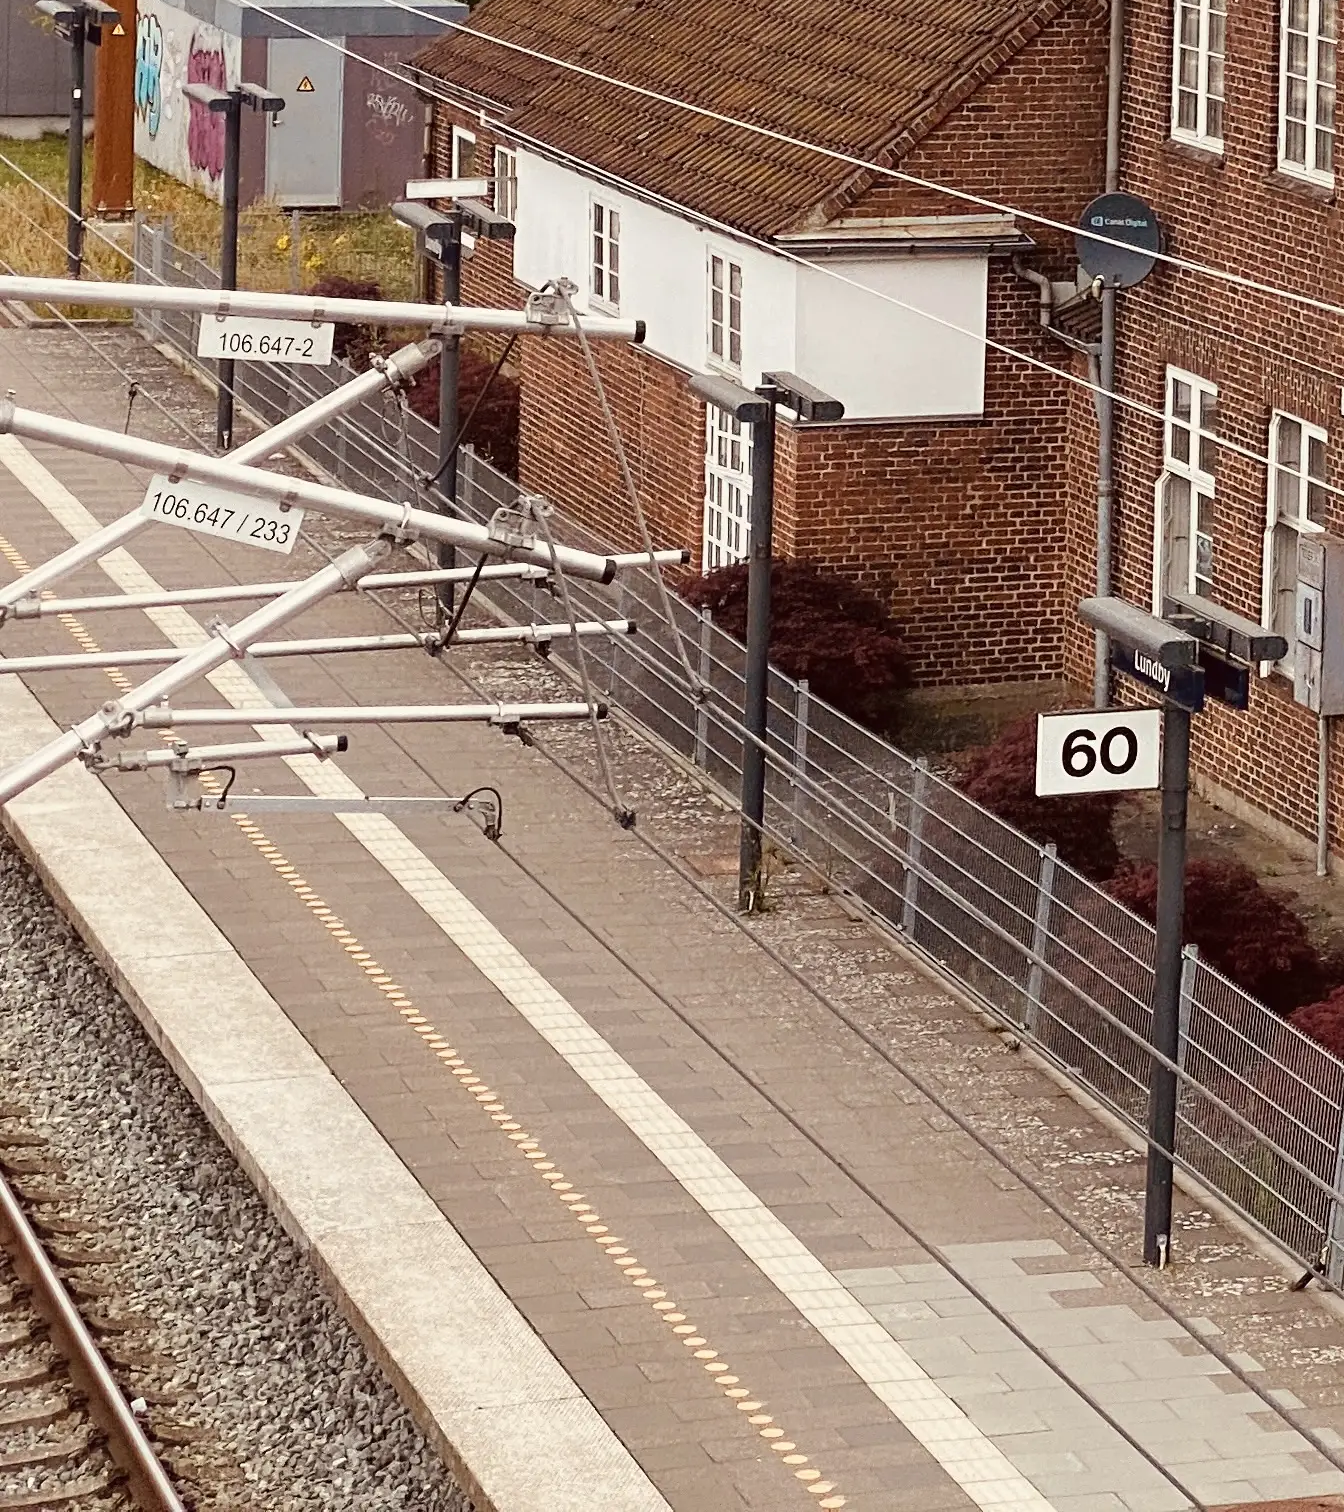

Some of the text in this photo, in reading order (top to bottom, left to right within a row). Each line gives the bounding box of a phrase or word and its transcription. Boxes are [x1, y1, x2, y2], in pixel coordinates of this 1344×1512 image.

[219, 332, 314, 358] 106.647-2
[153, 491, 291, 545] 106.647 / 233
[1134, 648, 1171, 692] Lundby
[1062, 726, 1138, 778] 60
